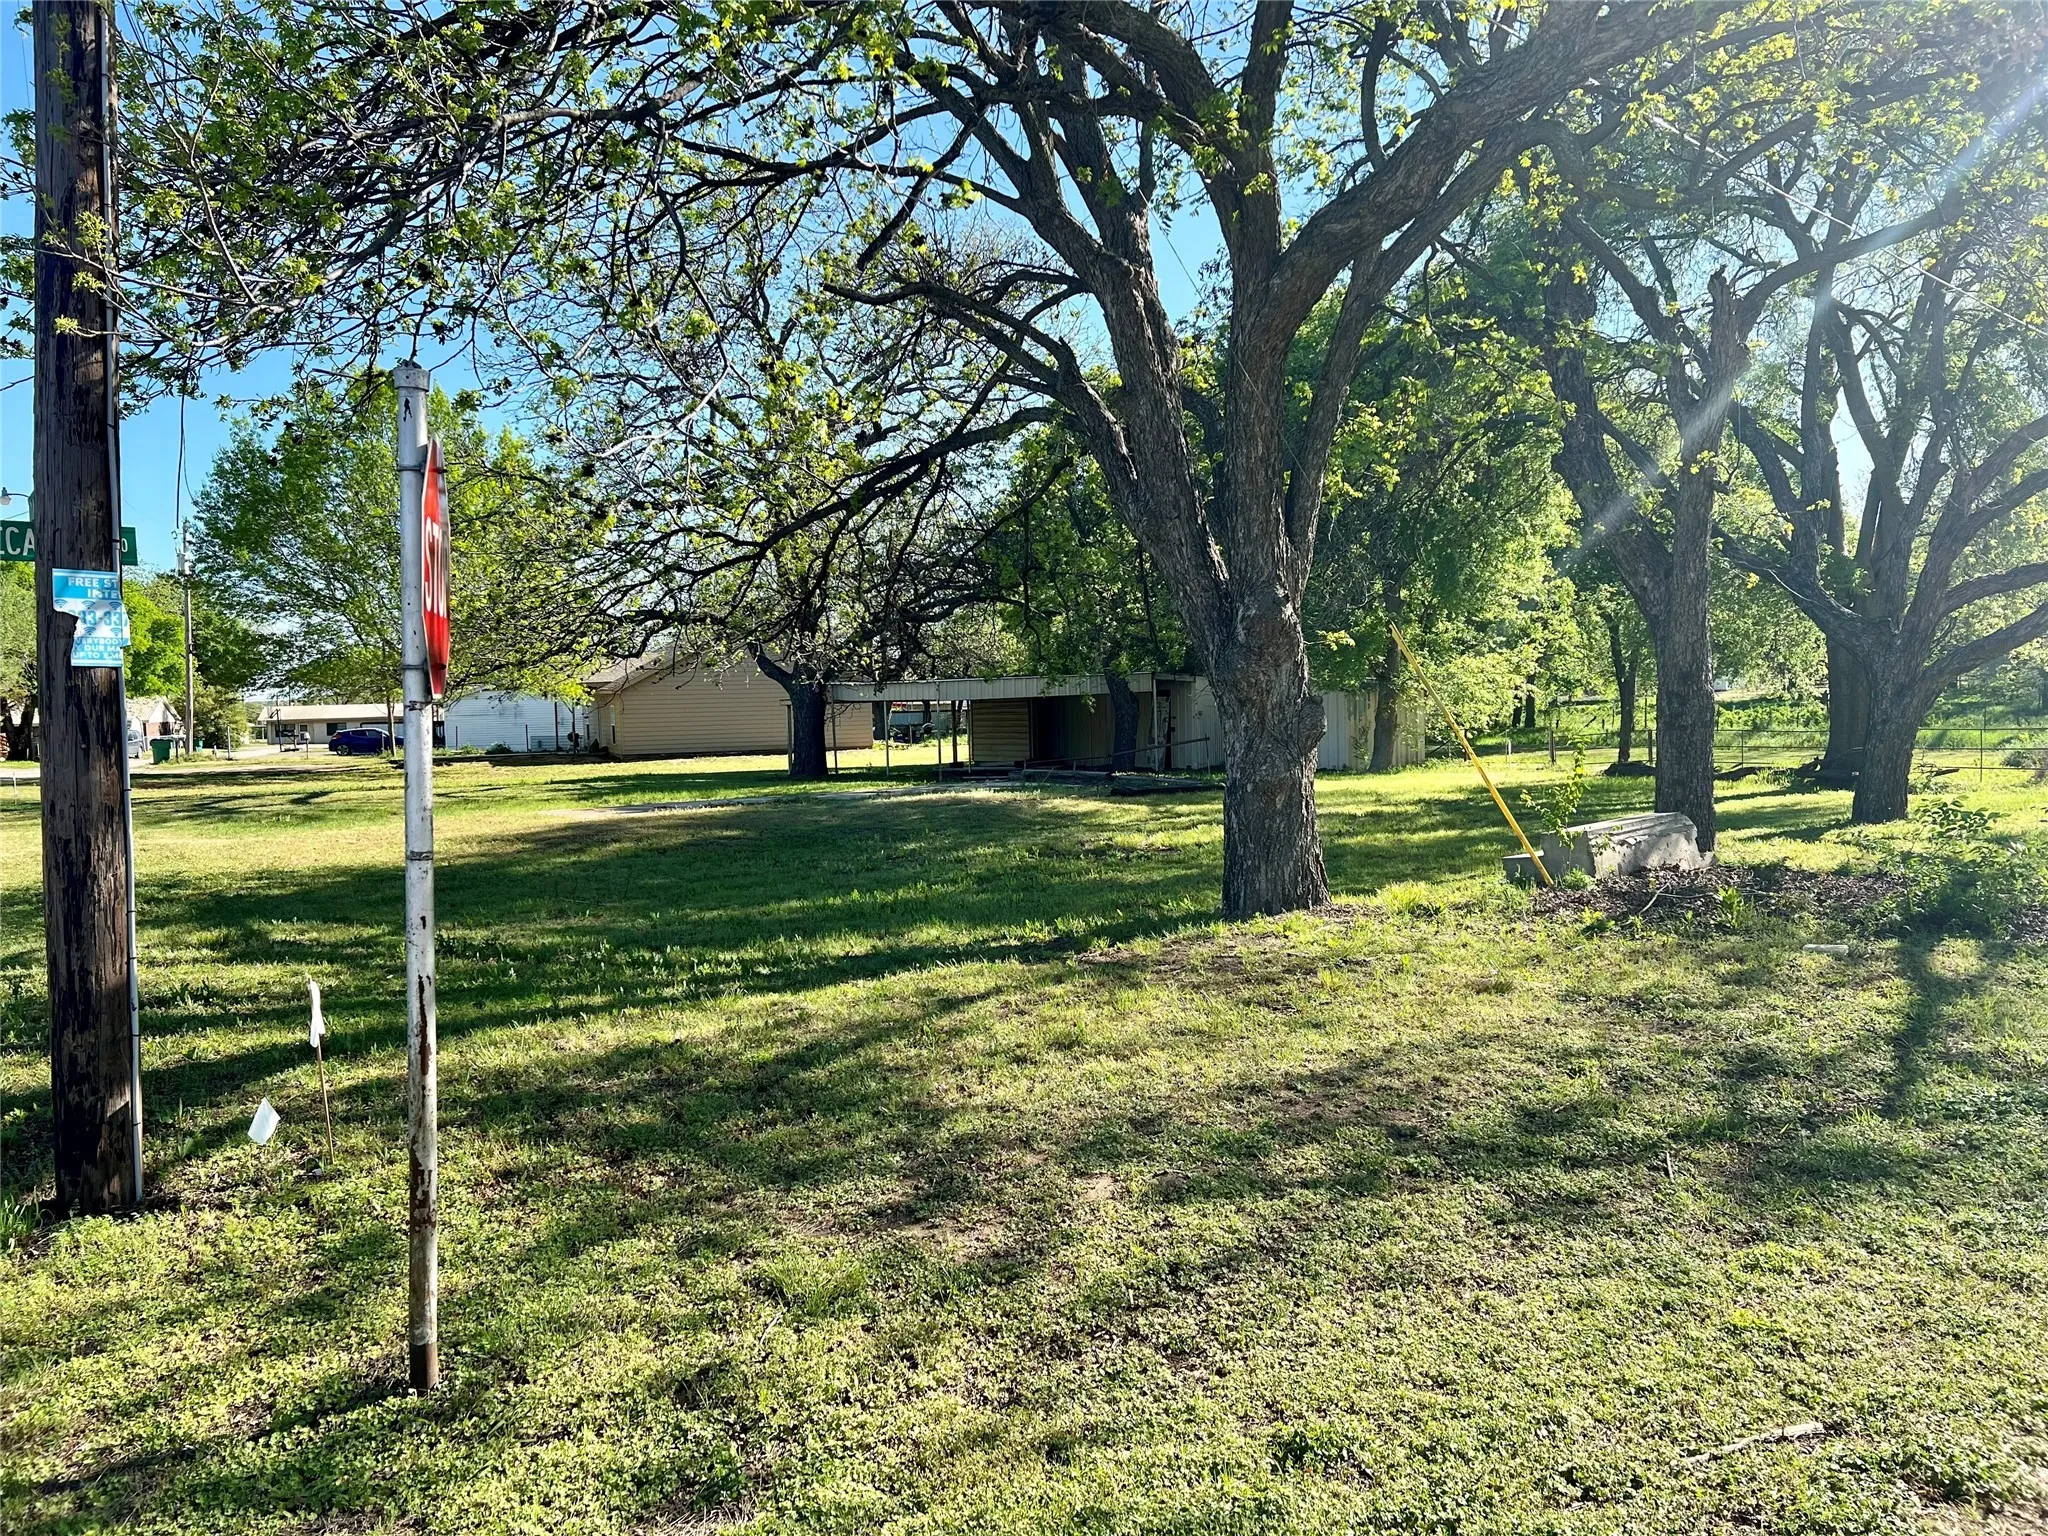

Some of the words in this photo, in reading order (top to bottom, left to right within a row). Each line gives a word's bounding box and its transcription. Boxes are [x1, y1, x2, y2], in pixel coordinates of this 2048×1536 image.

[425, 516, 449, 619] STOP
[68, 577, 100, 587] FREE
[87, 651, 100, 659] TO
